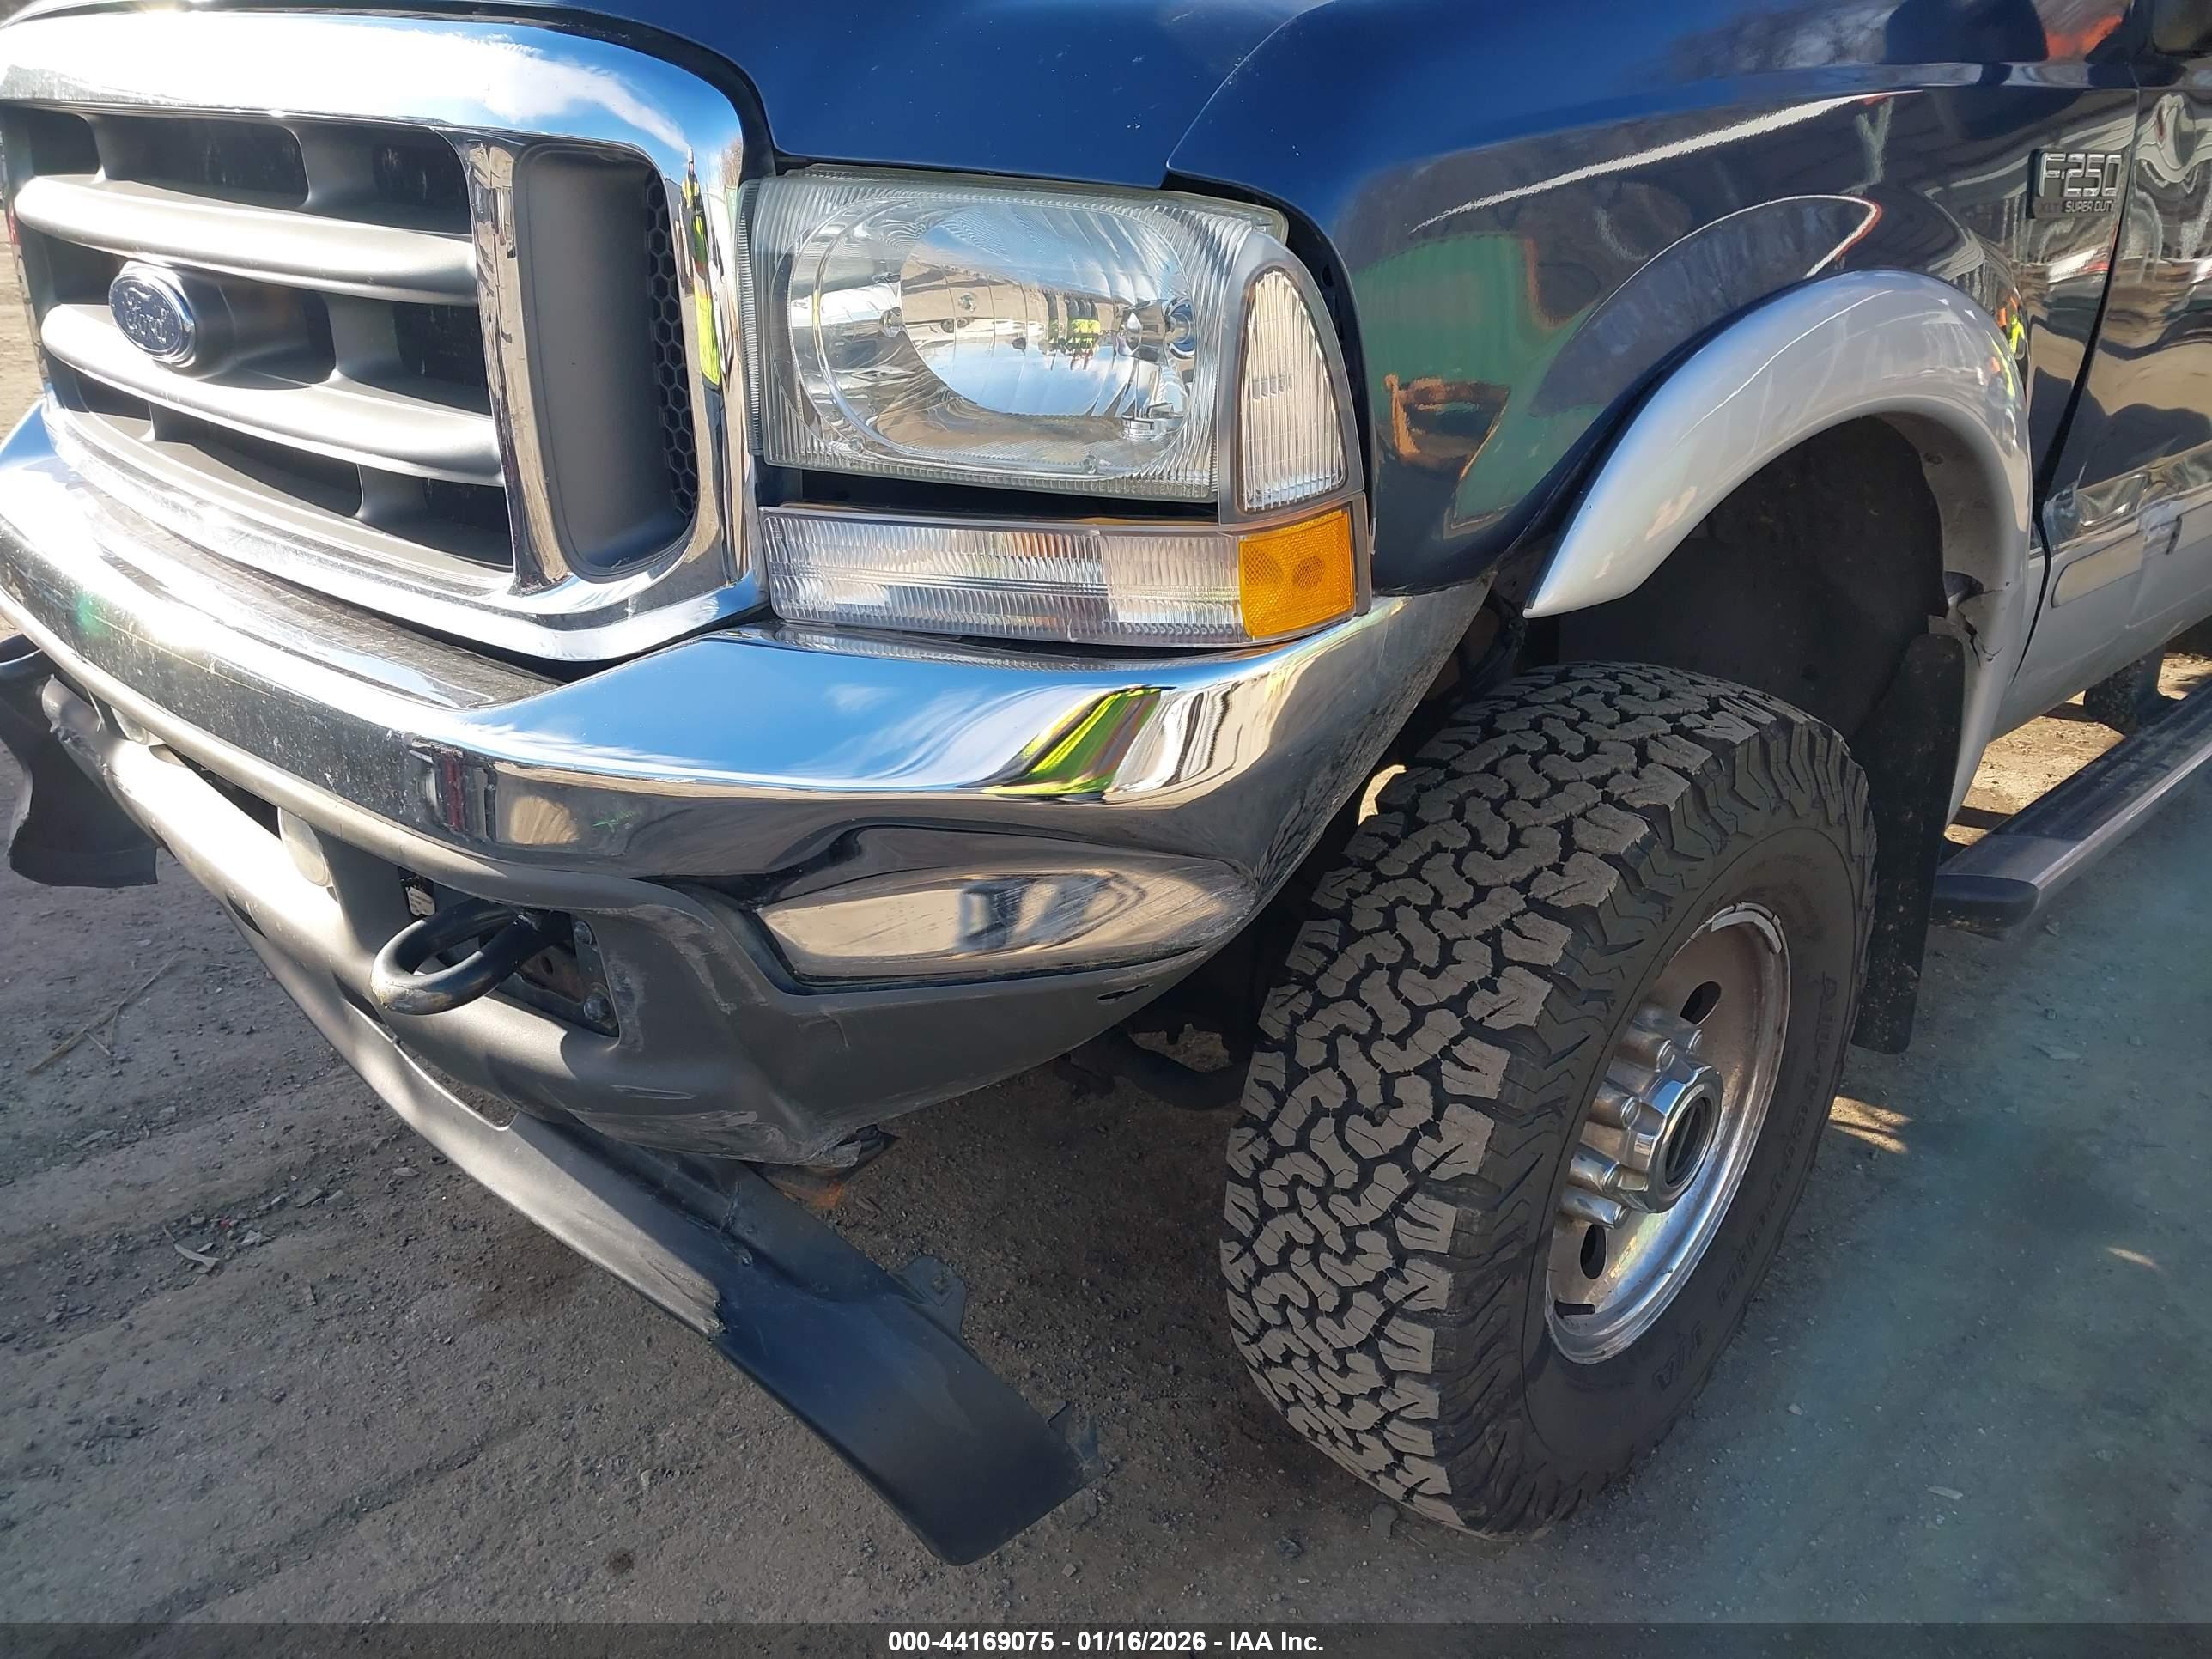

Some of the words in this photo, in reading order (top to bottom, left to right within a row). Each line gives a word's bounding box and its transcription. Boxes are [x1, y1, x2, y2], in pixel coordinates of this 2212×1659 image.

[2039, 152, 2122, 198] F-250
[2064, 200, 2093, 213] SUPER
[122, 286, 167, 344] Ford
